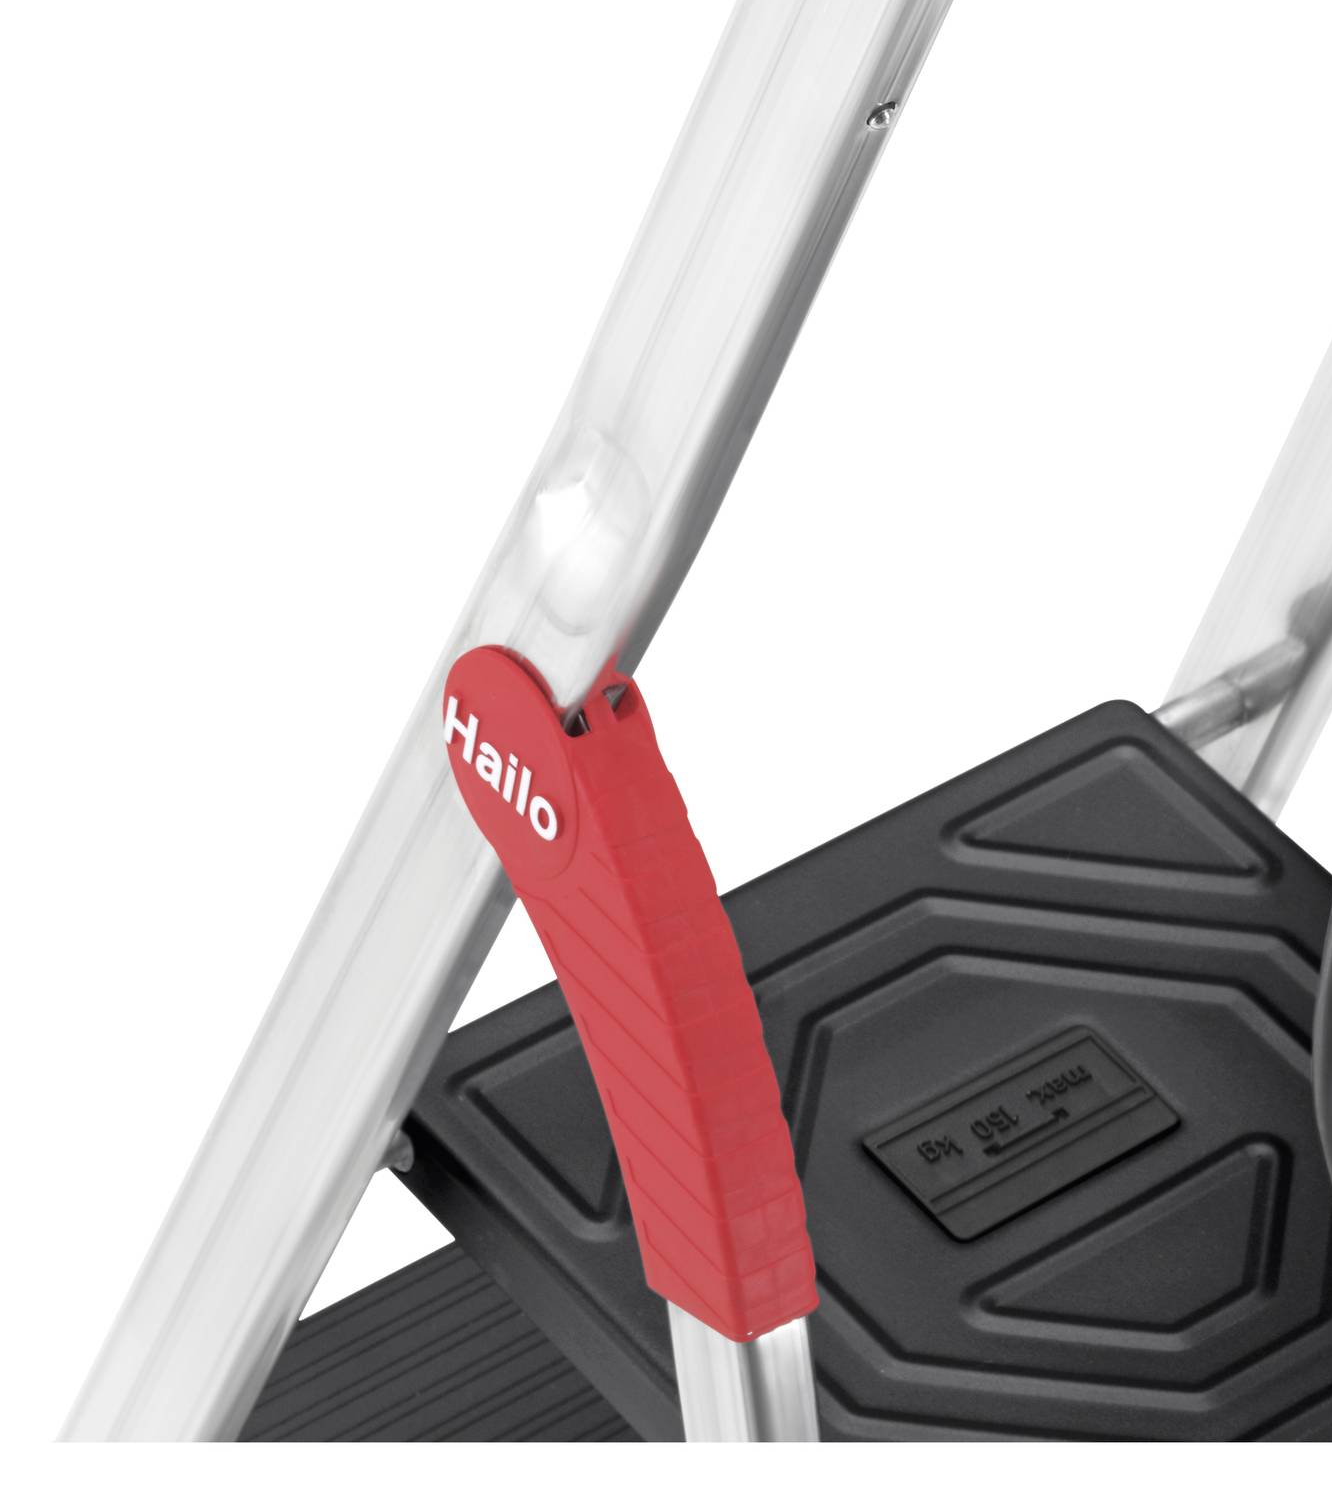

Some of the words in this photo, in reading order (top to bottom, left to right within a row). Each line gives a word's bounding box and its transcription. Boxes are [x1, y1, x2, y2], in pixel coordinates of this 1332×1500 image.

[444, 695, 558, 841] Hailo
[1026, 1065, 1093, 1106] max.
[970, 1105, 1019, 1141] 150
[917, 1135, 964, 1164] kg
